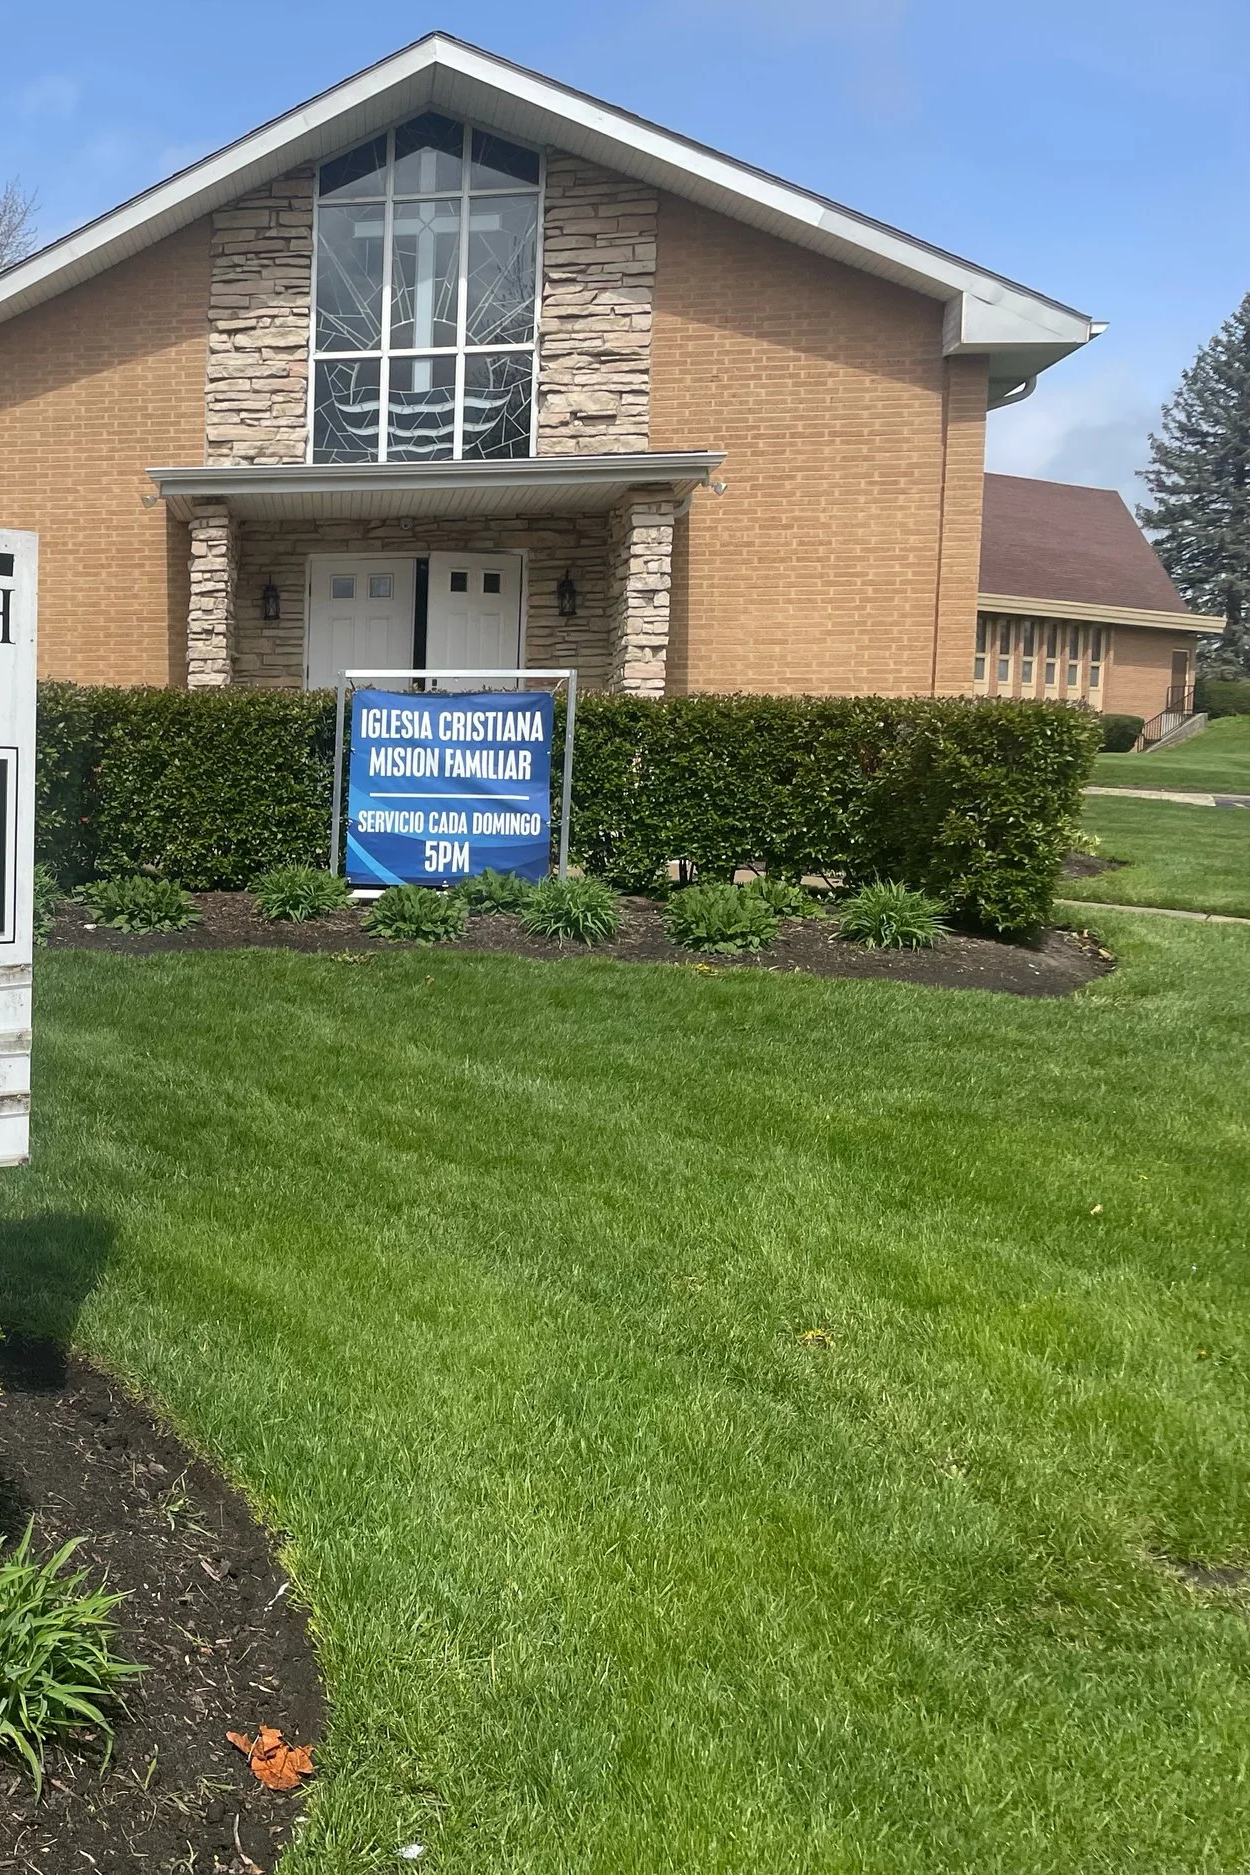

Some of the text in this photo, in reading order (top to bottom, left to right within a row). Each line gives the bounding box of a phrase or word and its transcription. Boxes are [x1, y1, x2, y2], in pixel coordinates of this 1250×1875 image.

[361, 708, 544, 742] IGLESIA CRISTIANA
[369, 747, 531, 780] MISION FAMILIAR
[358, 811, 541, 836] SERVICIO CADA DOMINGO
[424, 840, 470, 873] 5PM
